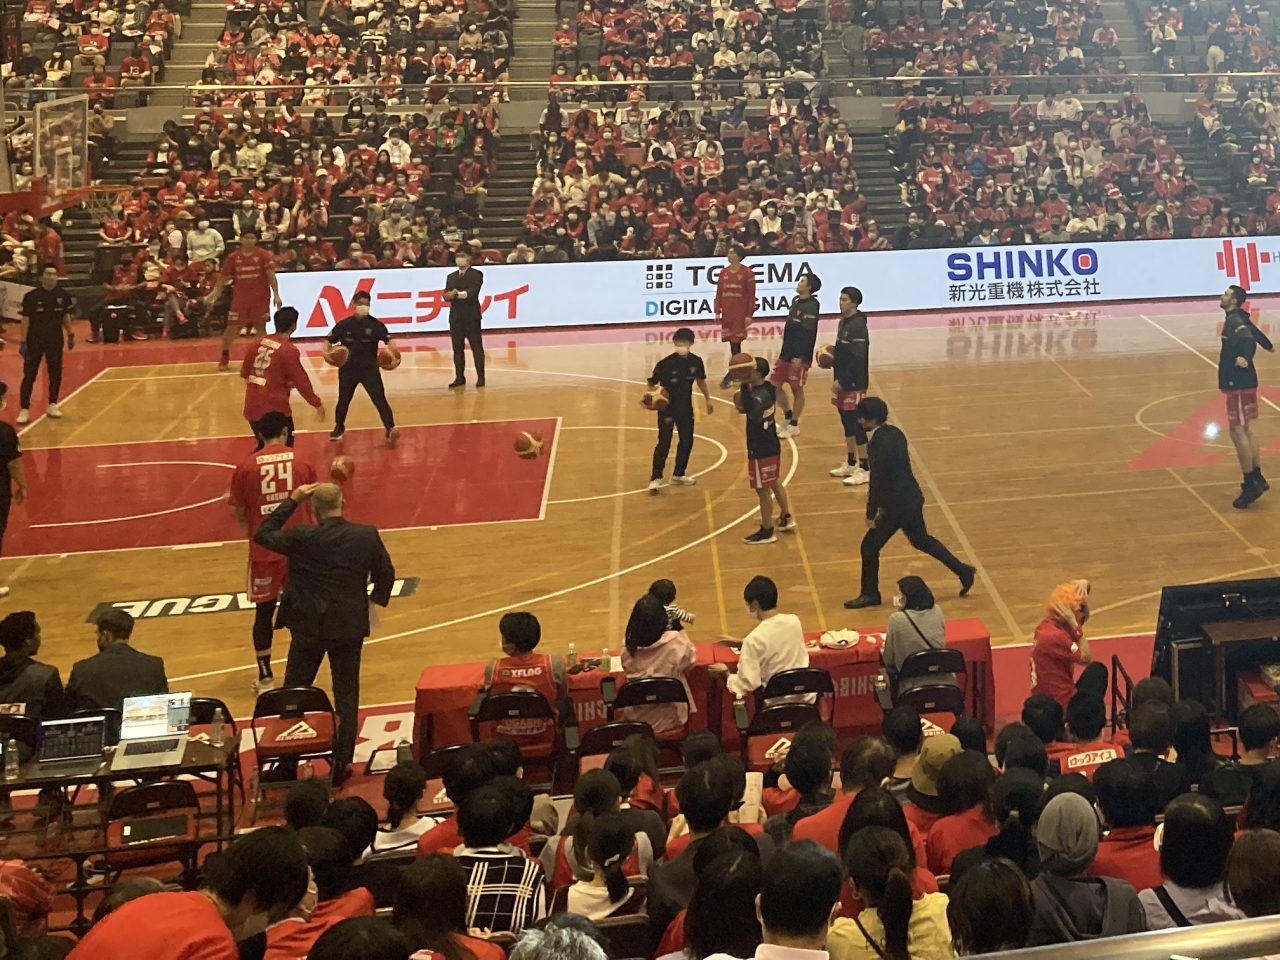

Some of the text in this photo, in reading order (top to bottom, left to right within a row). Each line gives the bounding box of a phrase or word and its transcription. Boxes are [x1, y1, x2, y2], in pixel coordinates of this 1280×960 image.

[947, 247, 1099, 282] SHINKO
[948, 278, 1100, 302] 新光重機株式会社
[260, 461, 293, 494] 24
[511, 667, 542, 677] XFLAG
[1067, 750, 1117, 768] ロックアイス
